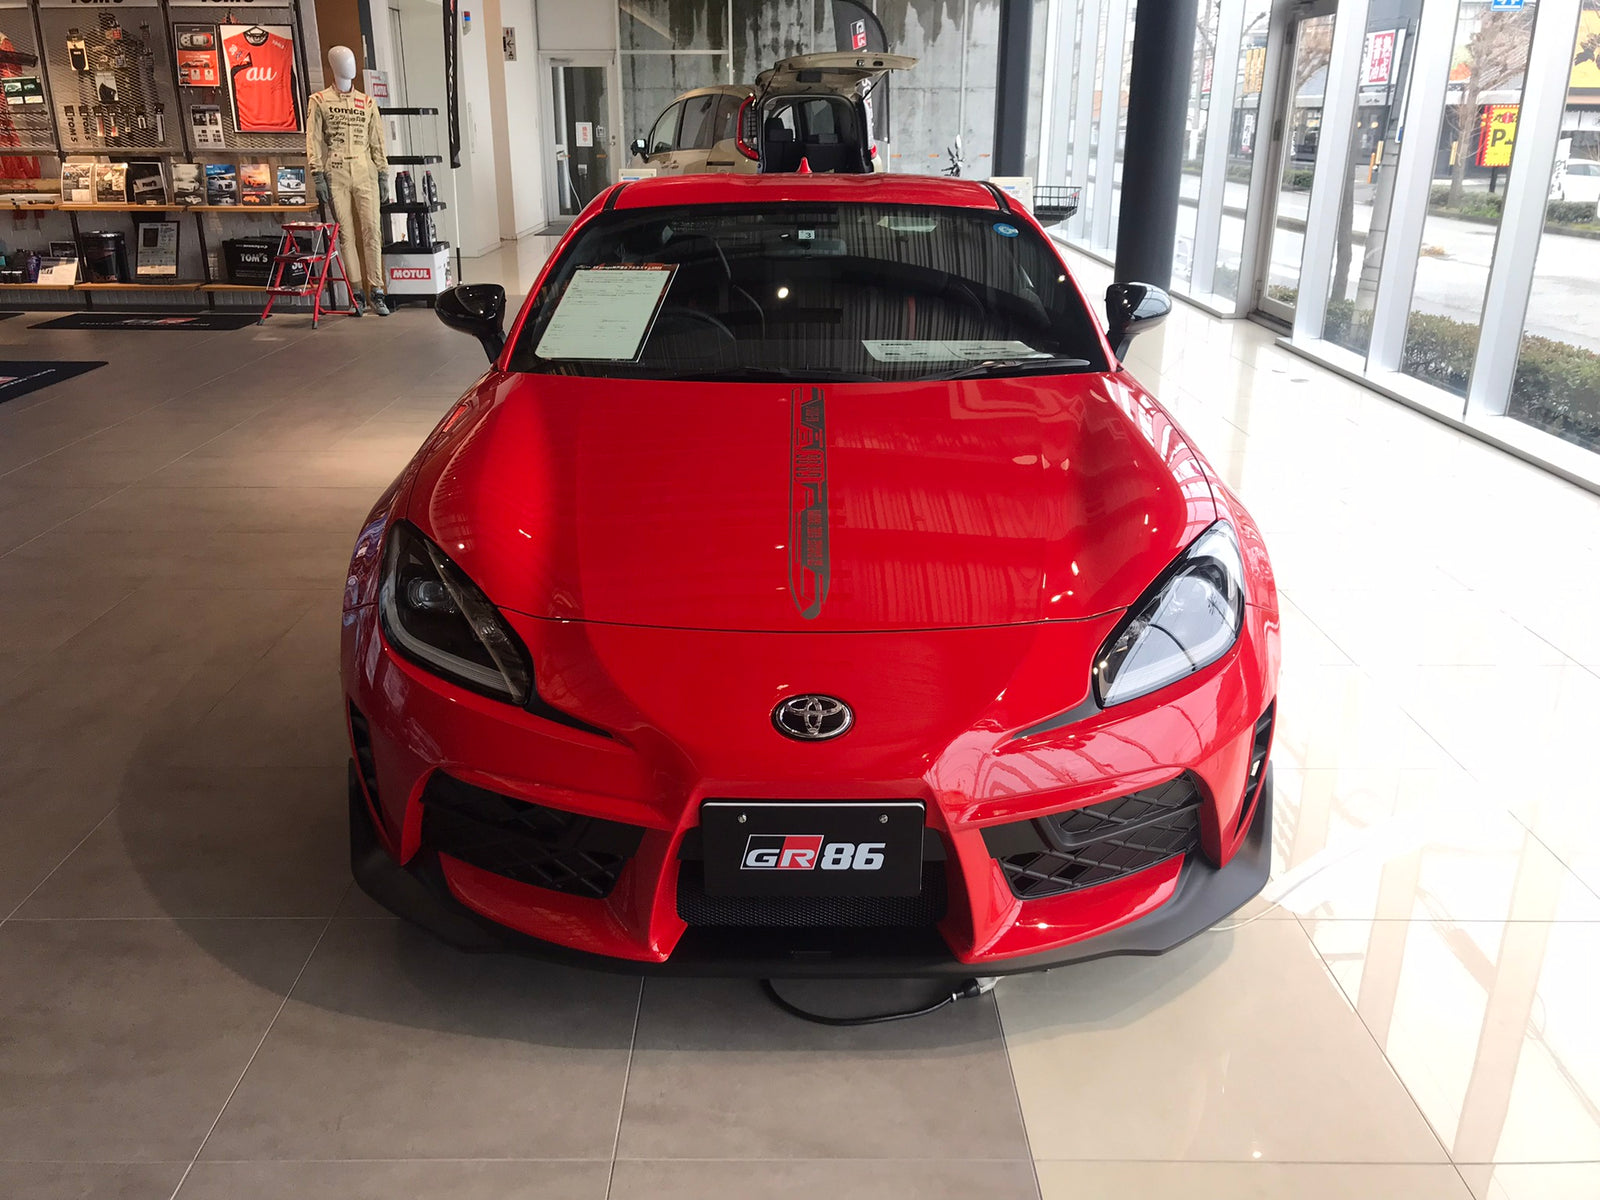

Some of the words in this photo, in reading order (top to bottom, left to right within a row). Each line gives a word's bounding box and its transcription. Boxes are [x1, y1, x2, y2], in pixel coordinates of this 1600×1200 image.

[245, 64, 278, 82] au
[328, 106, 366, 116] tomica
[1491, 129, 1507, 147] P
[392, 269, 429, 279] MOTUL
[744, 842, 887, 870] GR86
